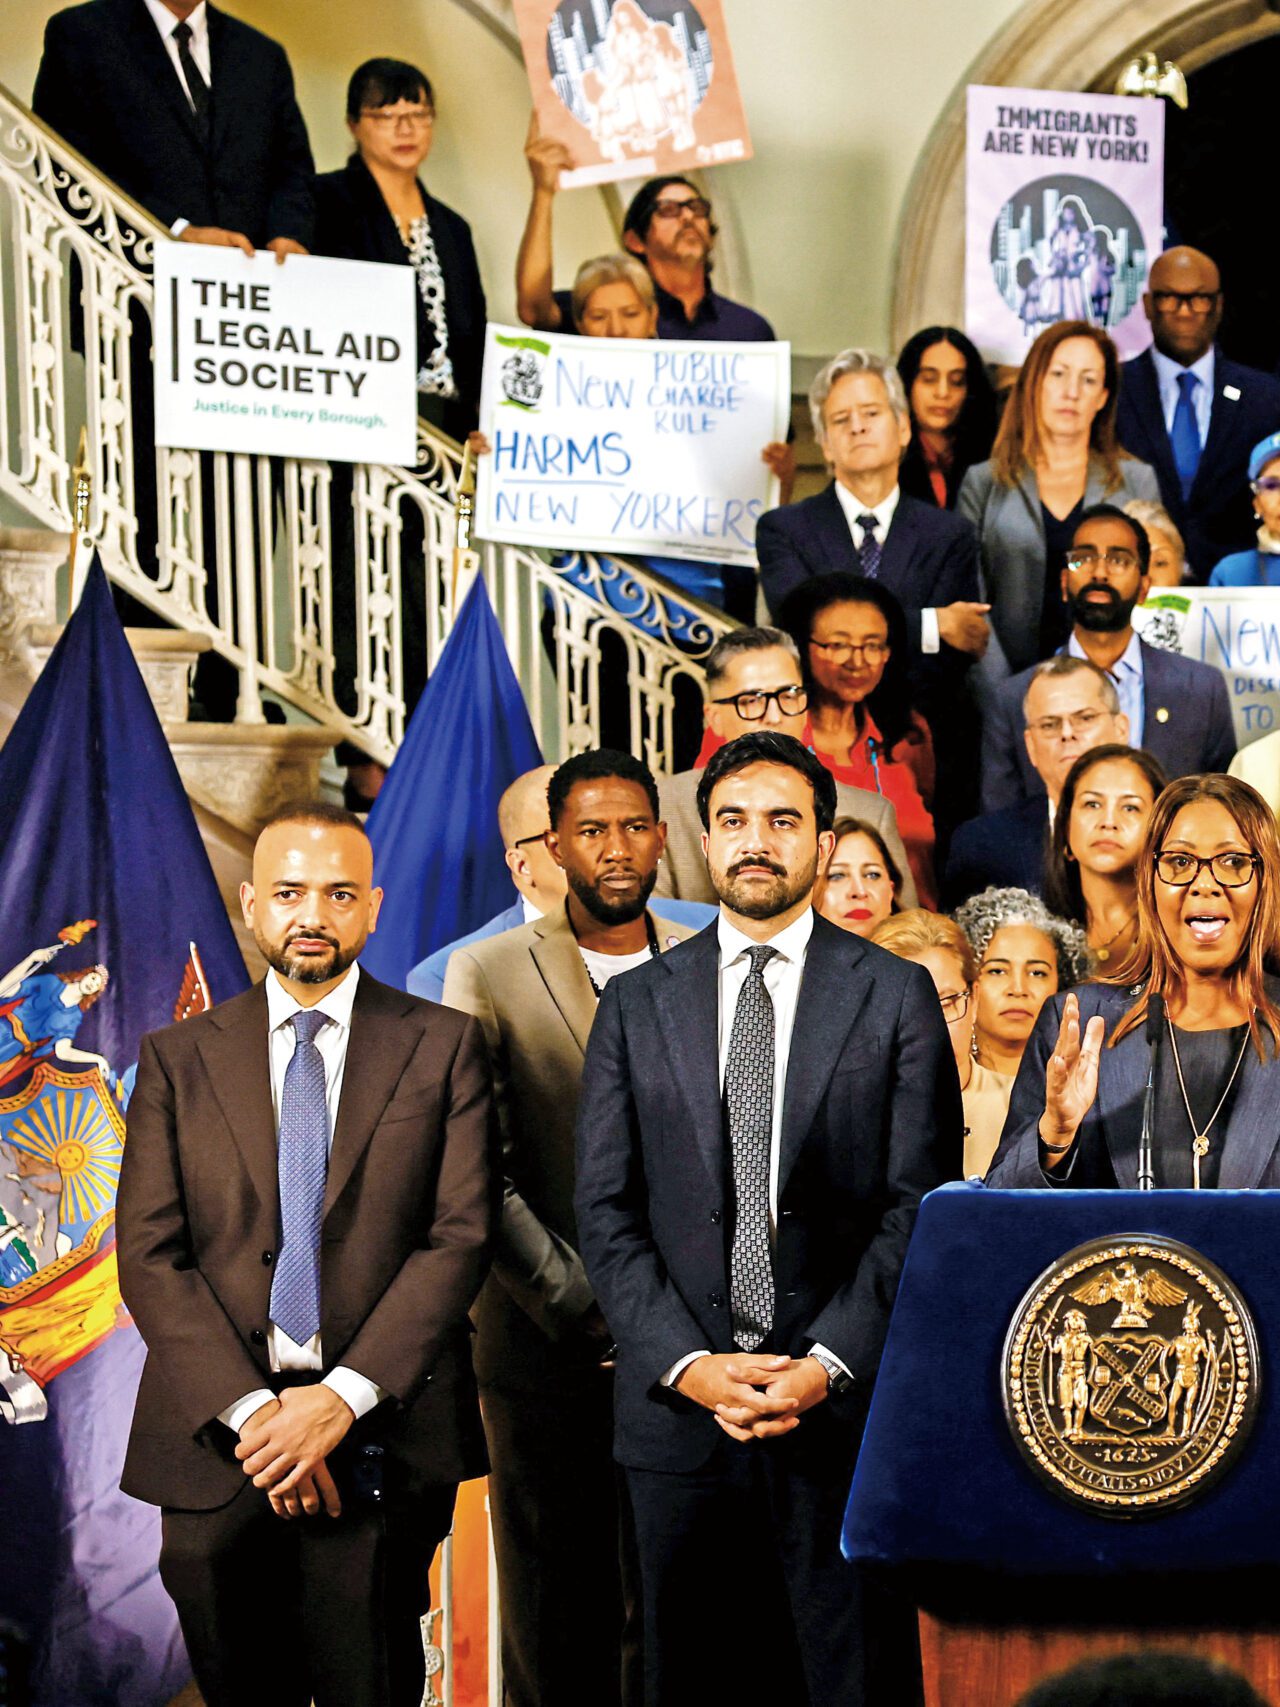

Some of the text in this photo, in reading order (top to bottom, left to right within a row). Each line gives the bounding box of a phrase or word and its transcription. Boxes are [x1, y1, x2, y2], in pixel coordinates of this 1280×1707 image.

[997, 106, 1137, 136] IMMIGRANTS
[984, 131, 1149, 163] ARE NEW YORK!
[192, 279, 271, 312] THE
[194, 318, 401, 363] LEGAL AID
[194, 358, 368, 398] SOCIETY
[556, 358, 745, 411] New CHARGE
[654, 351, 749, 385] PUBLIC
[194, 399, 387, 428] Justice in Every Borough.
[654, 411, 718, 434] RULE
[495, 430, 632, 476] HARMS
[496, 491, 578, 525] NEW
[1241, 703, 1273, 731] TO
[1052, 1445, 1137, 1489] CIVITATIS
[1148, 1451, 1196, 1487] NOVI
